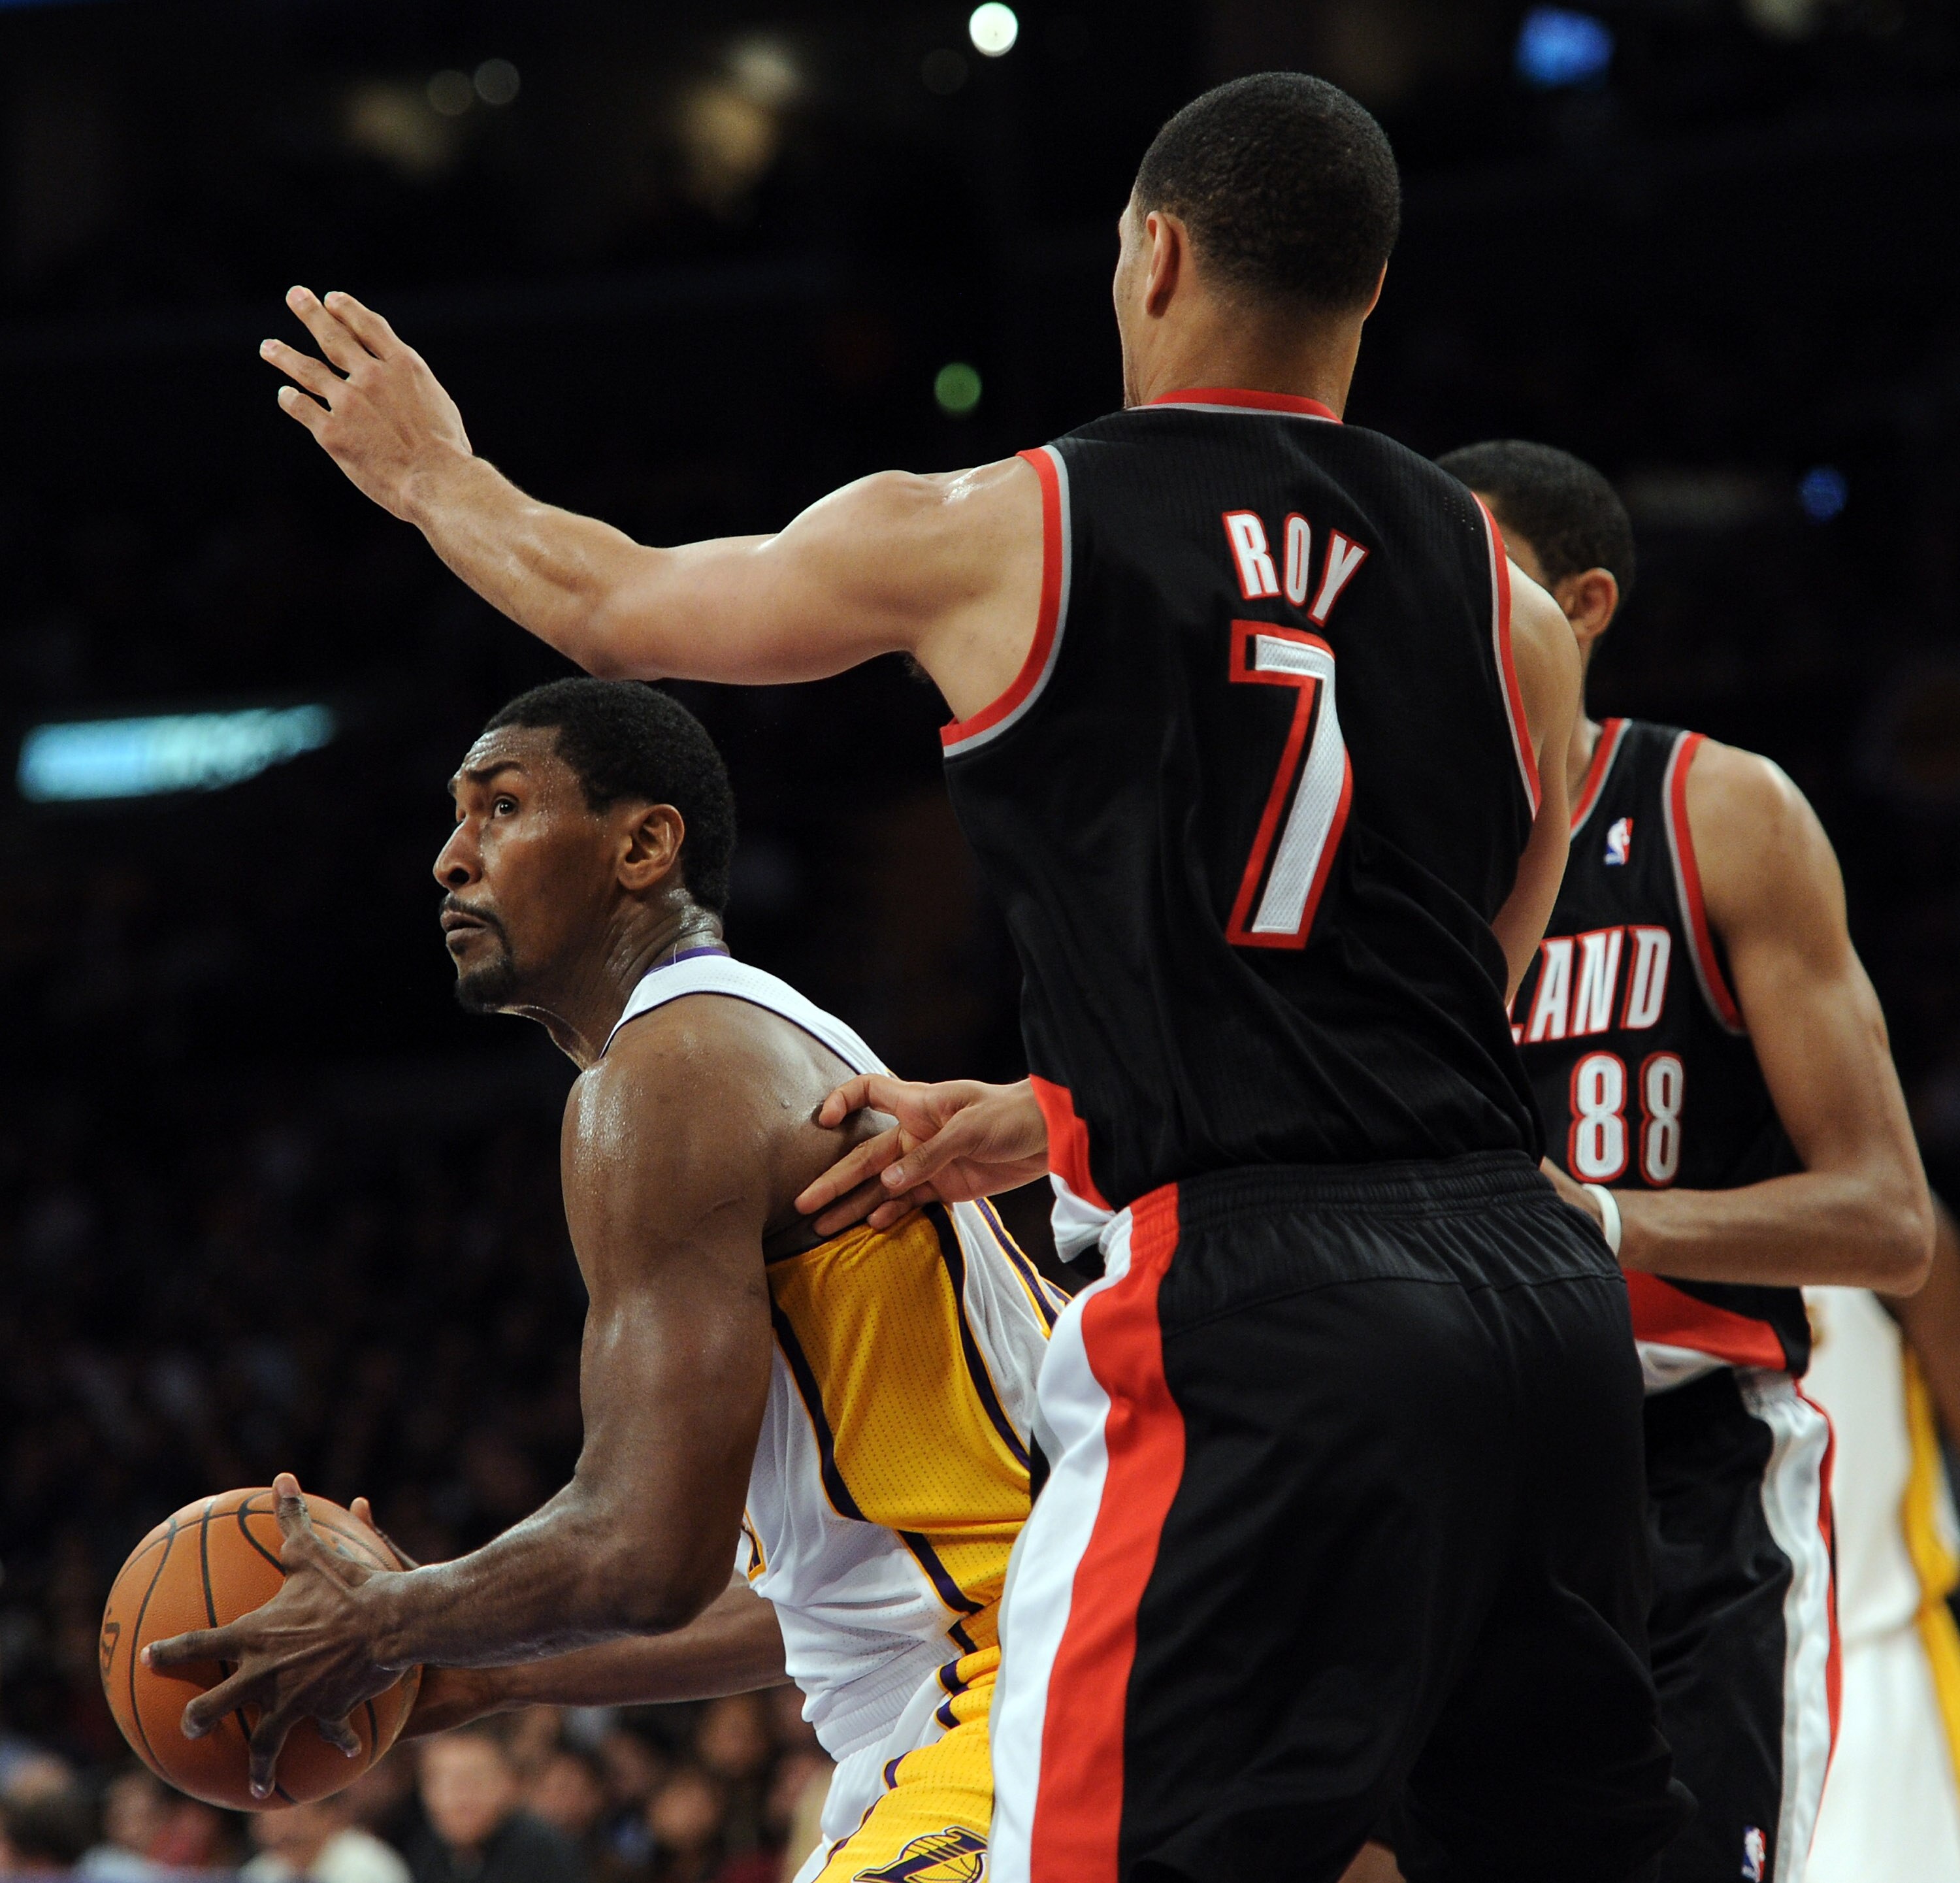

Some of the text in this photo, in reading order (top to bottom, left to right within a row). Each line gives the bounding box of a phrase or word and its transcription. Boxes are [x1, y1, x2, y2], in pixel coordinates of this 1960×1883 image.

[1222, 510, 1369, 627] ROY
[1226, 619, 1353, 949] 7
[1568, 1051, 1685, 1187] 88
